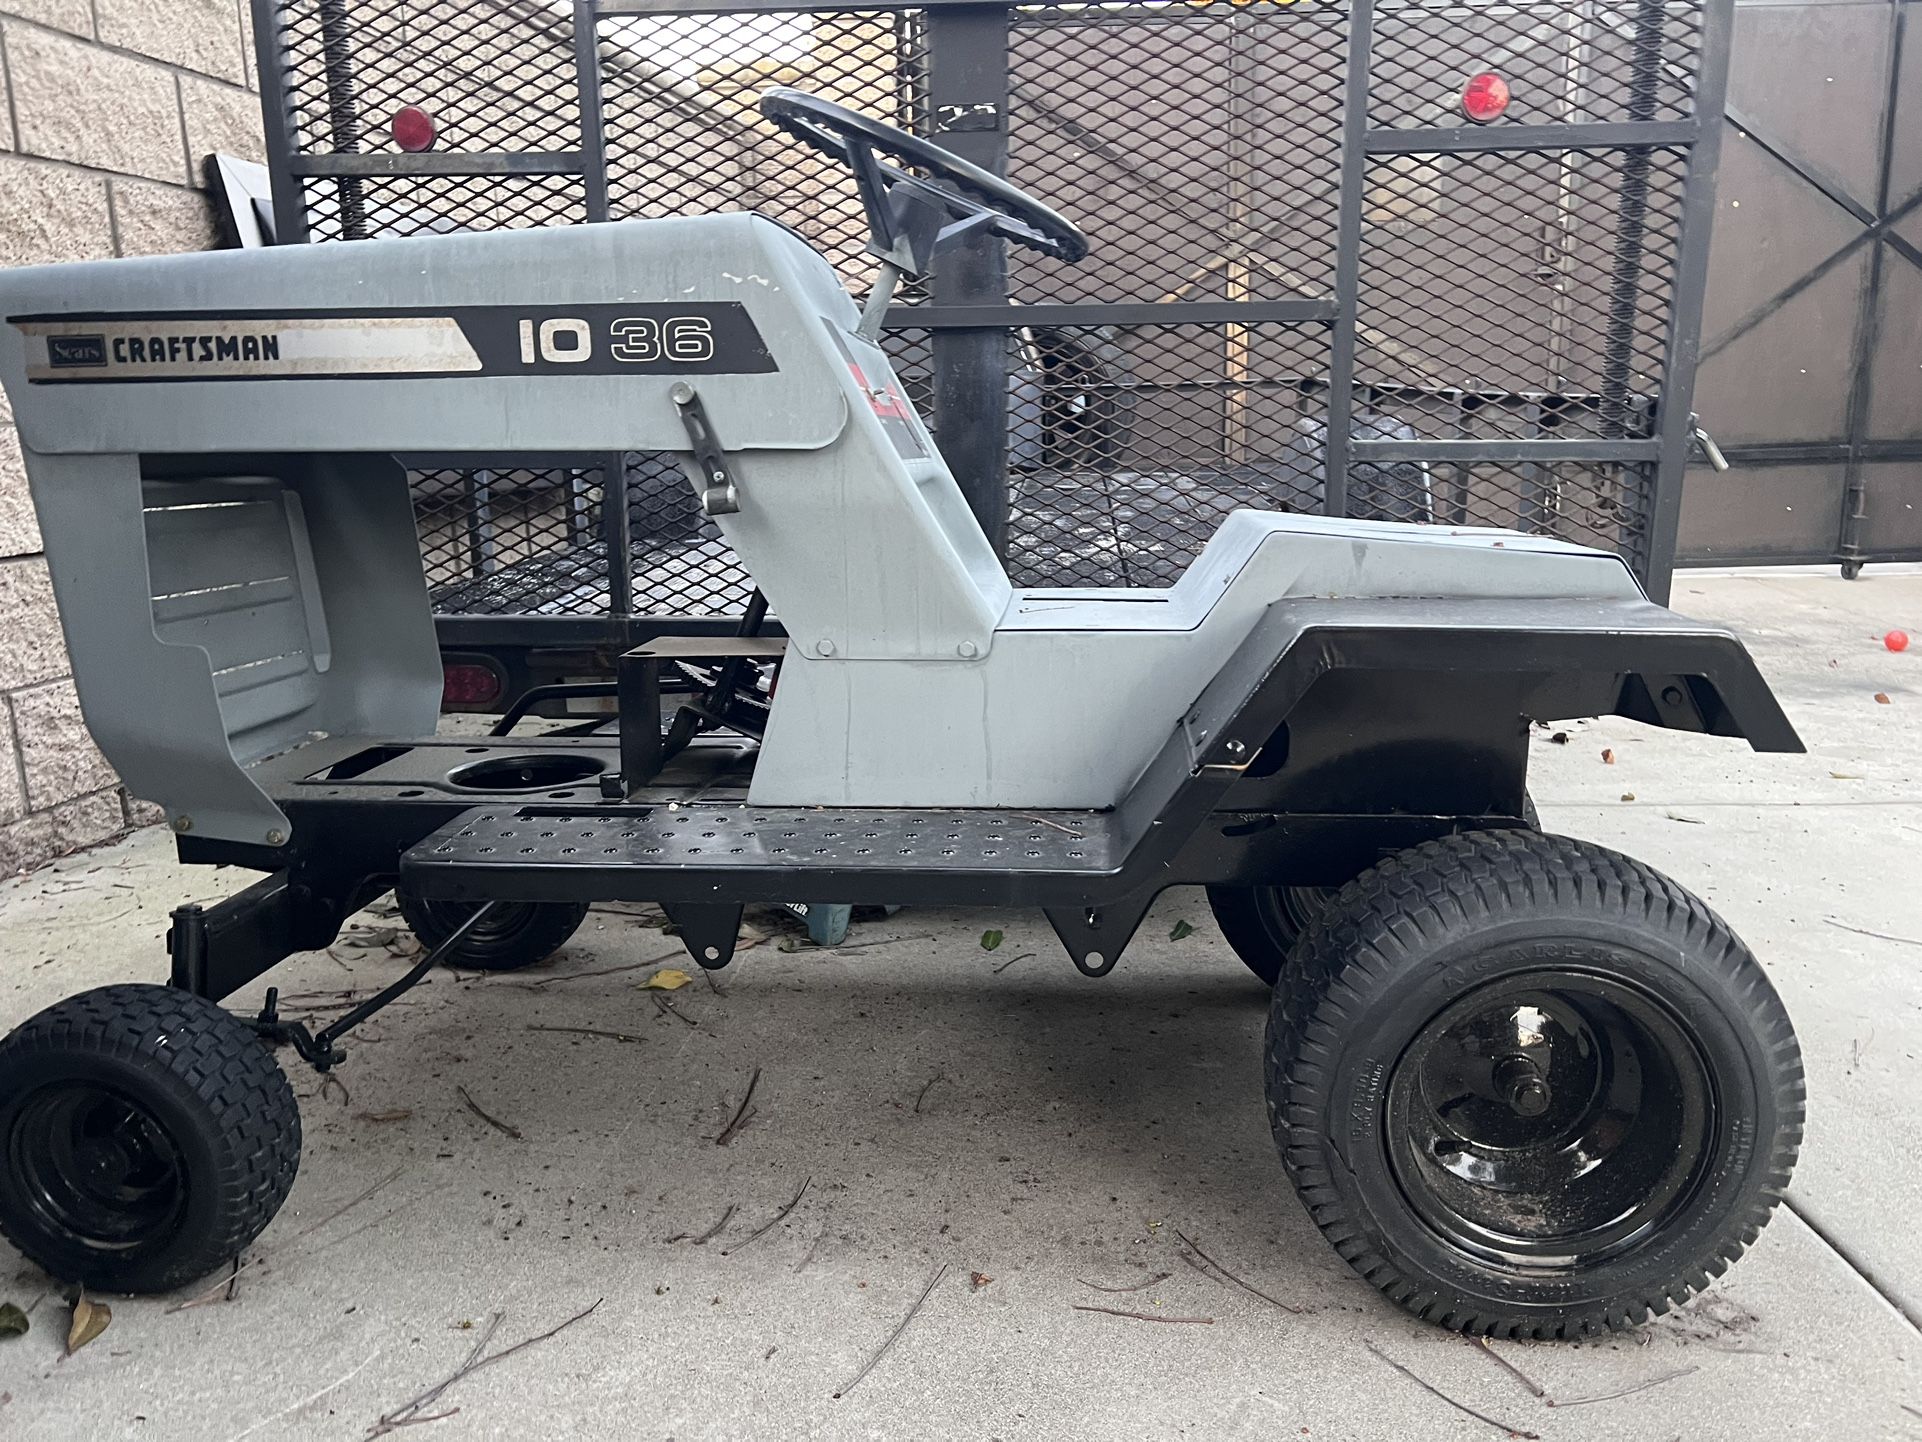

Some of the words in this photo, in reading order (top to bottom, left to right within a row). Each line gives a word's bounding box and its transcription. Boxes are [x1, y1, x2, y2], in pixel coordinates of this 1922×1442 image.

[113, 335, 279, 362] CRAFTSMAN
[519, 318, 592, 363] 10
[610, 317, 714, 362] 36
